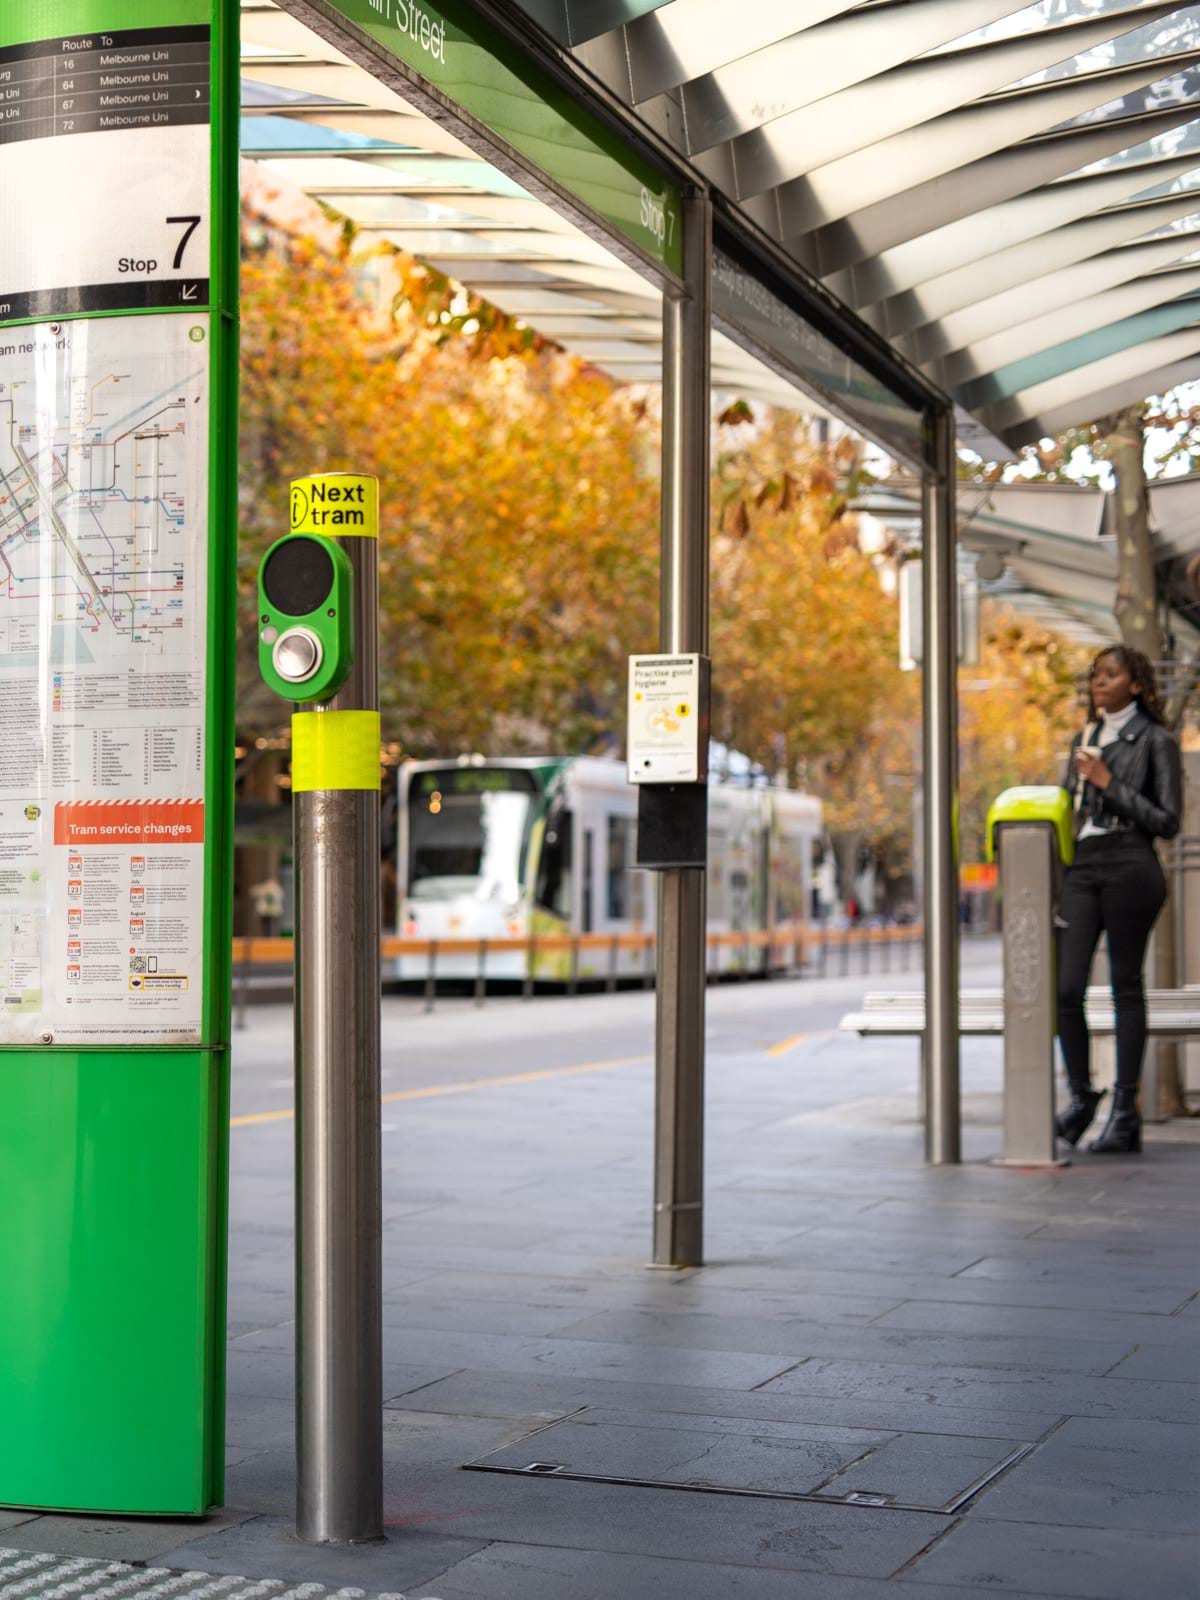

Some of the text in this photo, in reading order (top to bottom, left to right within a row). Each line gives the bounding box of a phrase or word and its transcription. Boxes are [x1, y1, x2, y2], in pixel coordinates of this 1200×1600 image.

[396, 0, 445, 64] Street
[62, 36, 113, 51] Route To
[63, 51, 169, 69] 16 Melbourne Uni
[62, 71, 169, 90] 64 Melbourne Uni
[5, 88, 20, 99] Uni
[62, 91, 169, 110] 67 Melbourne Uni
[5, 108, 20, 119] Uni
[62, 112, 169, 130] 72 Melbourne Uni
[640, 186, 675, 249] Stop 7
[118, 215, 201, 274] Stop 7
[311, 482, 365, 503] Next
[311, 507, 365, 525] tram
[634, 667, 693, 679] Practise good
[634, 680, 667, 689] hygiene
[69, 823, 193, 836] Tram service changes
